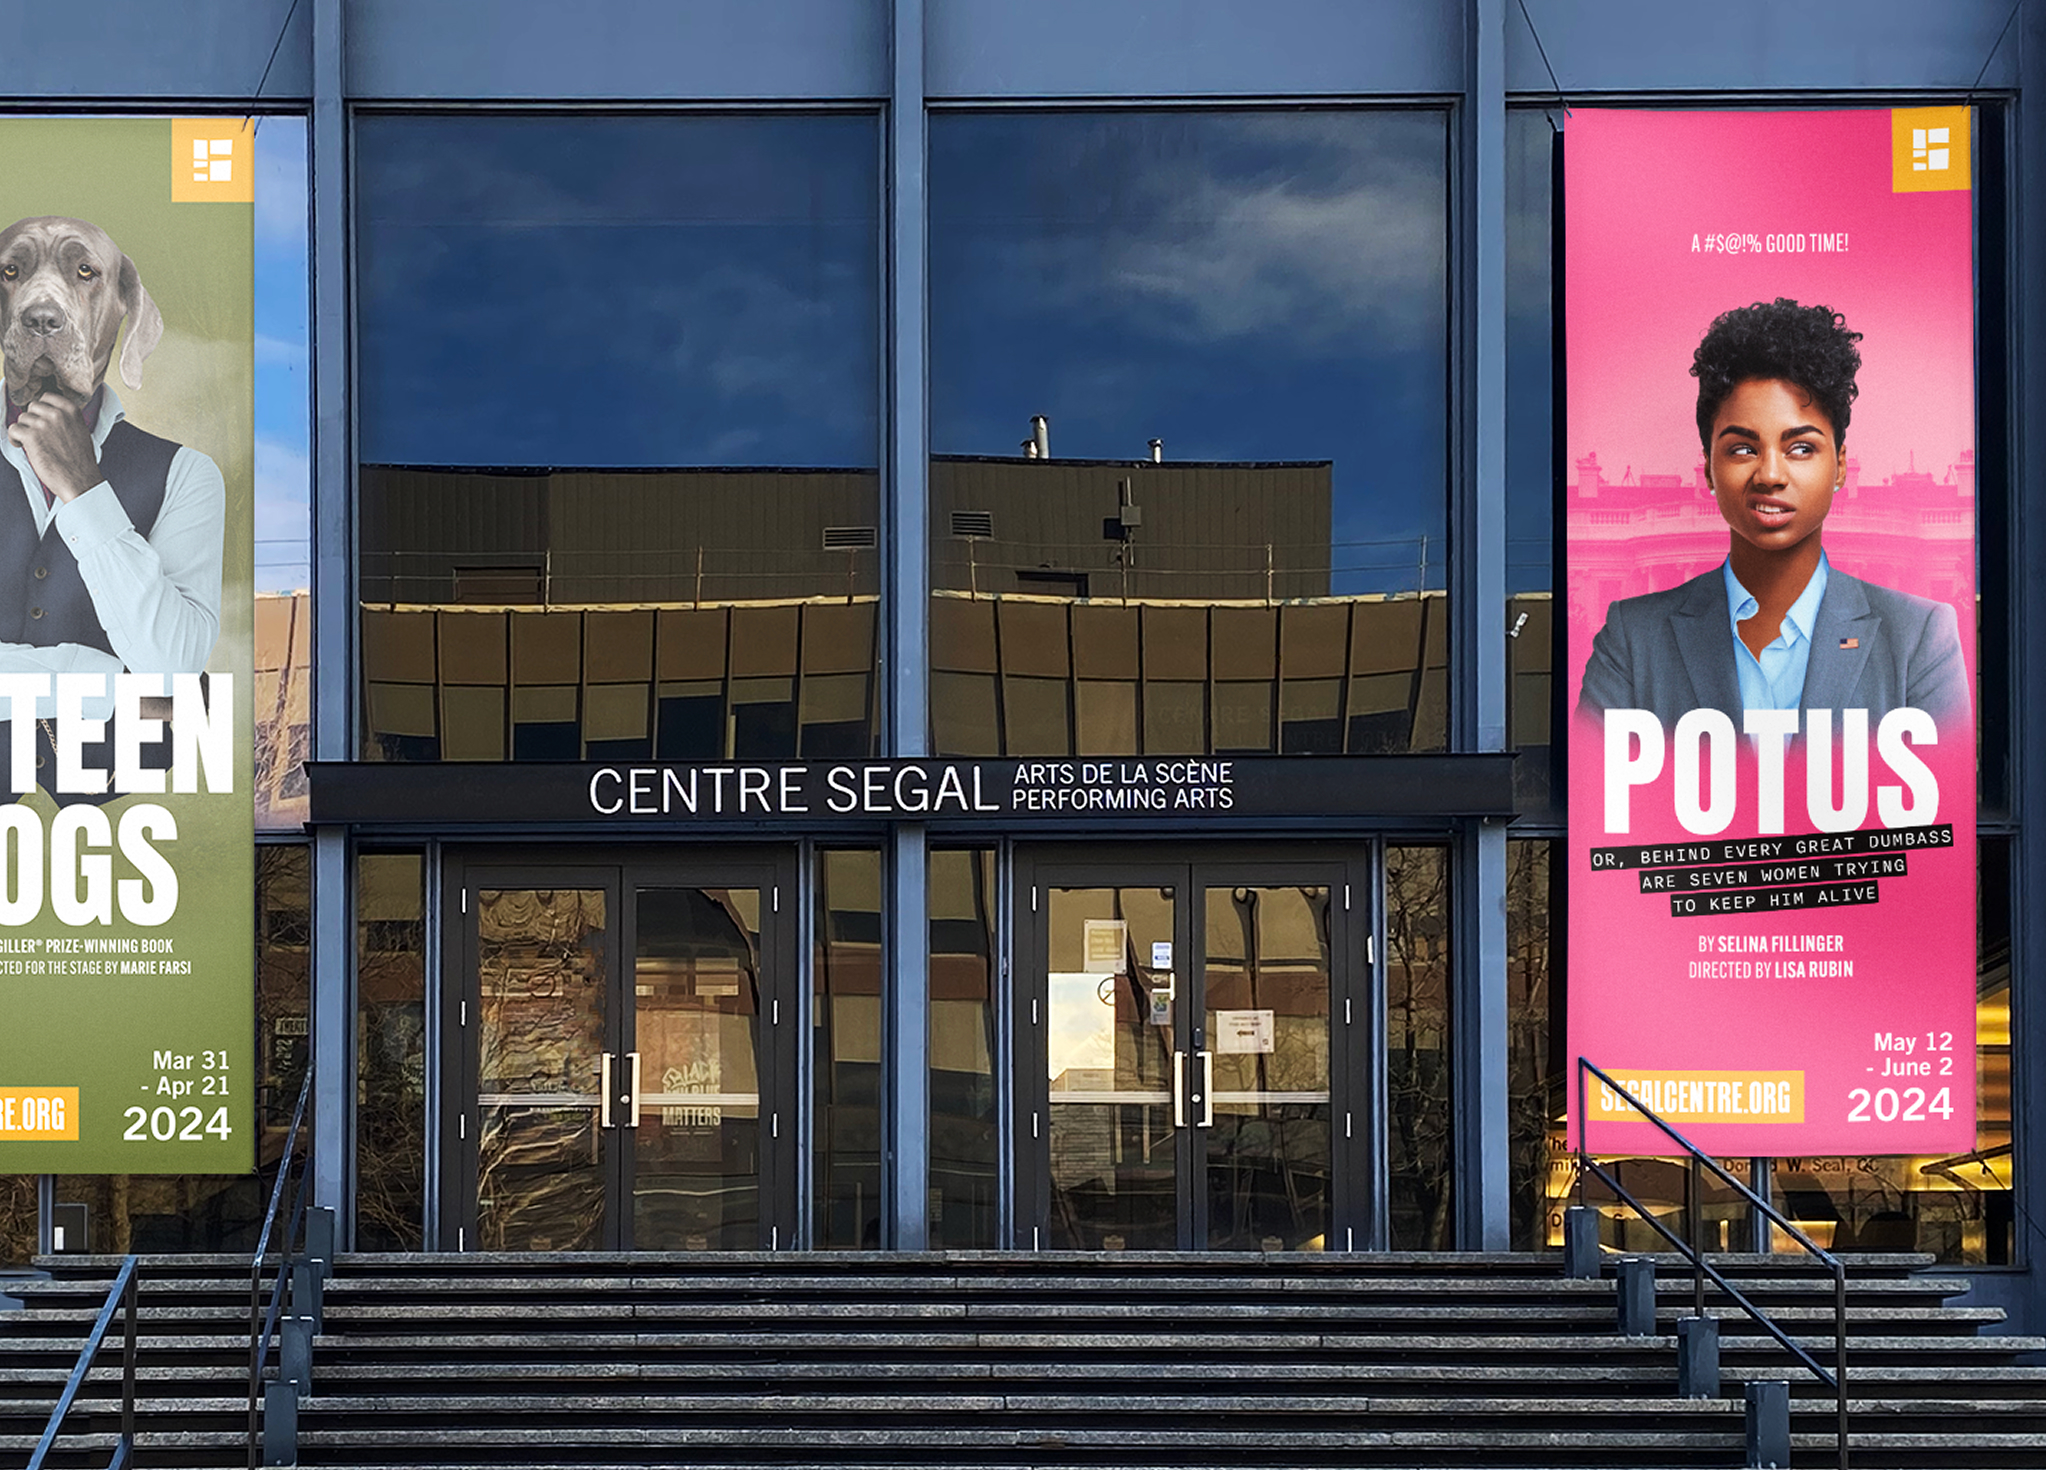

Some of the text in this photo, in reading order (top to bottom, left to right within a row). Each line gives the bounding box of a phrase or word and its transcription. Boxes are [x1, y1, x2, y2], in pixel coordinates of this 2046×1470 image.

[1691, 232, 1849, 255] A #$@!% GOOD TIME!
[0, 673, 234, 793] TEEN
[1014, 759, 1234, 784] ARTS DE LA SCÈNE
[1604, 707, 1940, 835] POTUS
[590, 766, 1000, 814] CENTRE SEGAL
[1012, 788, 1234, 810] PERFORMING ARTS
[1593, 829, 1952, 868] OR, BEHIND EVERY GREAT DUMBASS
[0, 803, 180, 926] OGS
[1642, 858, 1905, 889] ARE SEVEN WOMEN TRYING
[1673, 886, 1877, 912] TO KEEP HIM ALIVE
[46, 938, 139, 953] PRIZE-WINNING
[141, 938, 174, 953] BOOK
[1698, 934, 1844, 952] BY SELINA FILLINGER
[25, 960, 46, 975] FOR
[48, 960, 68, 975] THE
[69, 960, 102, 975] STAGE
[105, 960, 119, 975] BY
[120, 960, 157, 975] MARIE
[159, 960, 192, 975] FARSI
[1689, 960, 1853, 979] DIRECTED BY LISA RUBIN
[1874, 1031, 1953, 1056] May 12
[153, 1050, 230, 1070] Mar 31
[1881, 1057, 1931, 1077] June
[1939, 1057, 1953, 1075] 2
[156, 1076, 194, 1100] Apr
[201, 1076, 230, 1095] 21
[1600, 1079, 1791, 1115] SEGALCENTRE.ORG
[0, 1097, 66, 1131] E.ORG
[662, 1106, 722, 1127] MATTERS
[1847, 1086, 1955, 1122] 2024
[122, 1105, 232, 1141] 2024
